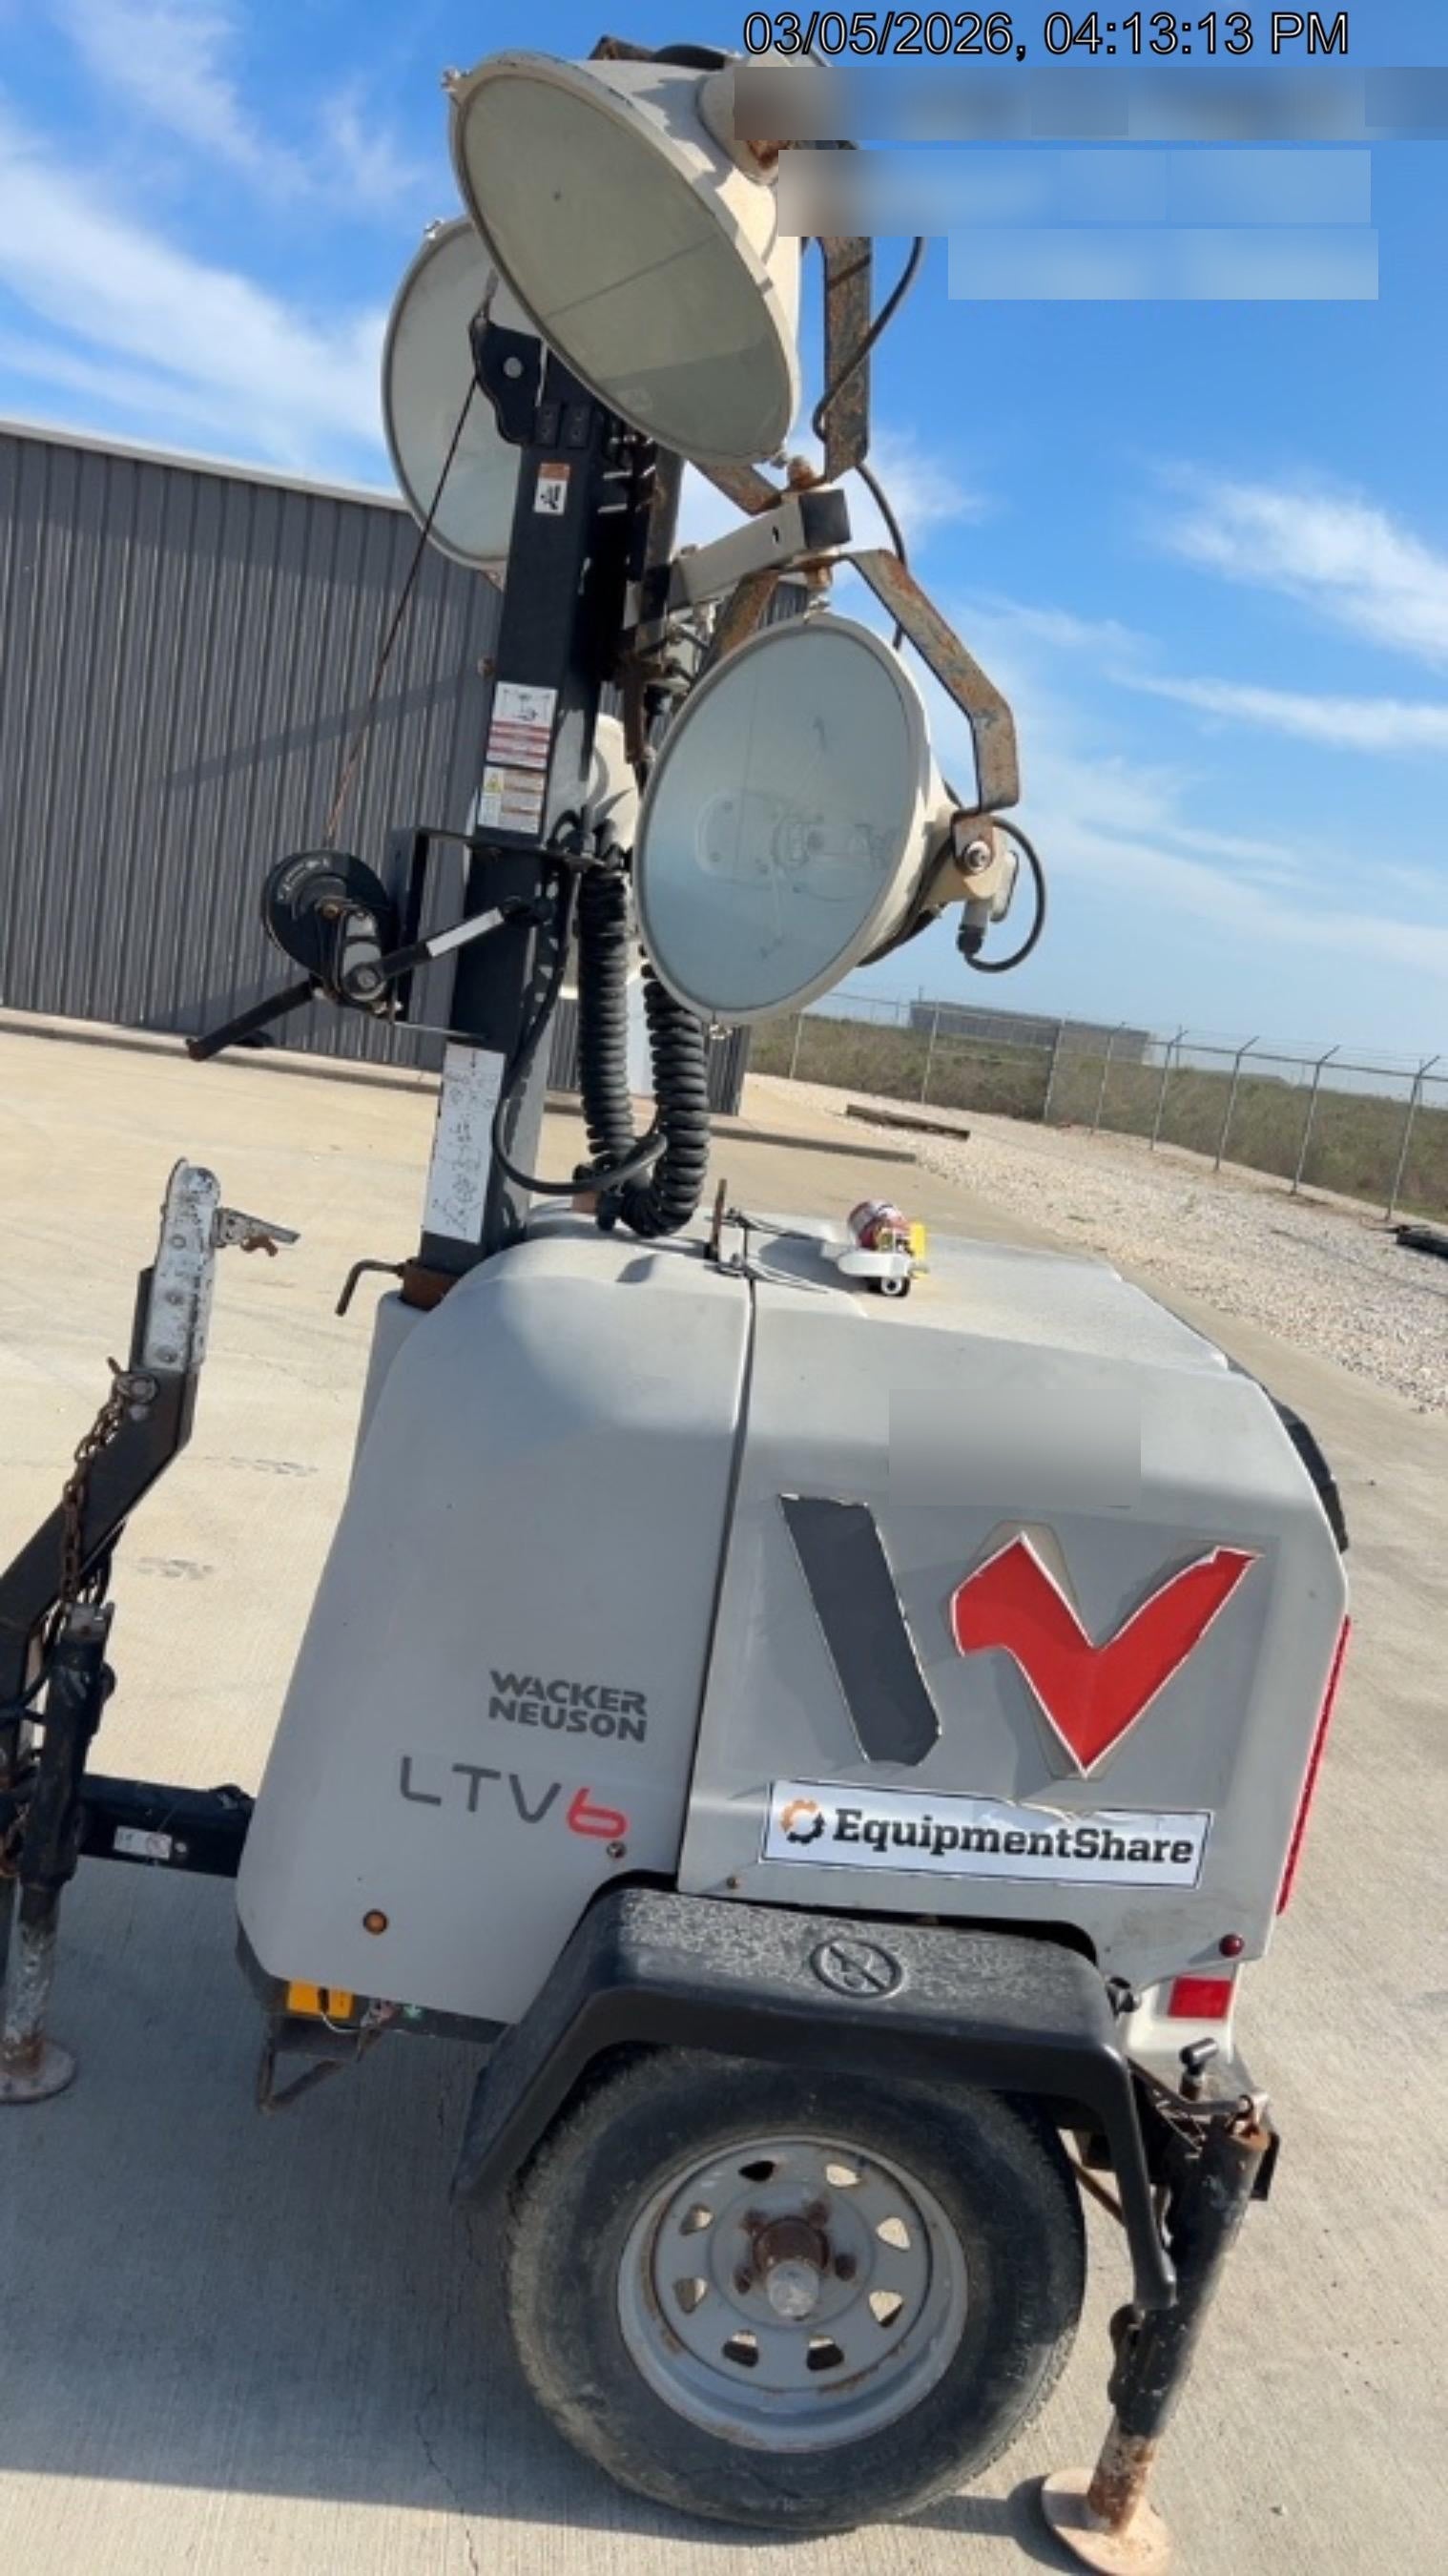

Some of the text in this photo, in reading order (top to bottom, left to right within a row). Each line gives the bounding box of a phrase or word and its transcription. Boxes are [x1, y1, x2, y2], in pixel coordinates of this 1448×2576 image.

[488, 1696, 648, 1743] NEUSON
[489, 1670, 648, 1717] WACKER
[399, 1755, 628, 1839] LTV6
[833, 1808, 1194, 1865] EquipmentShare
